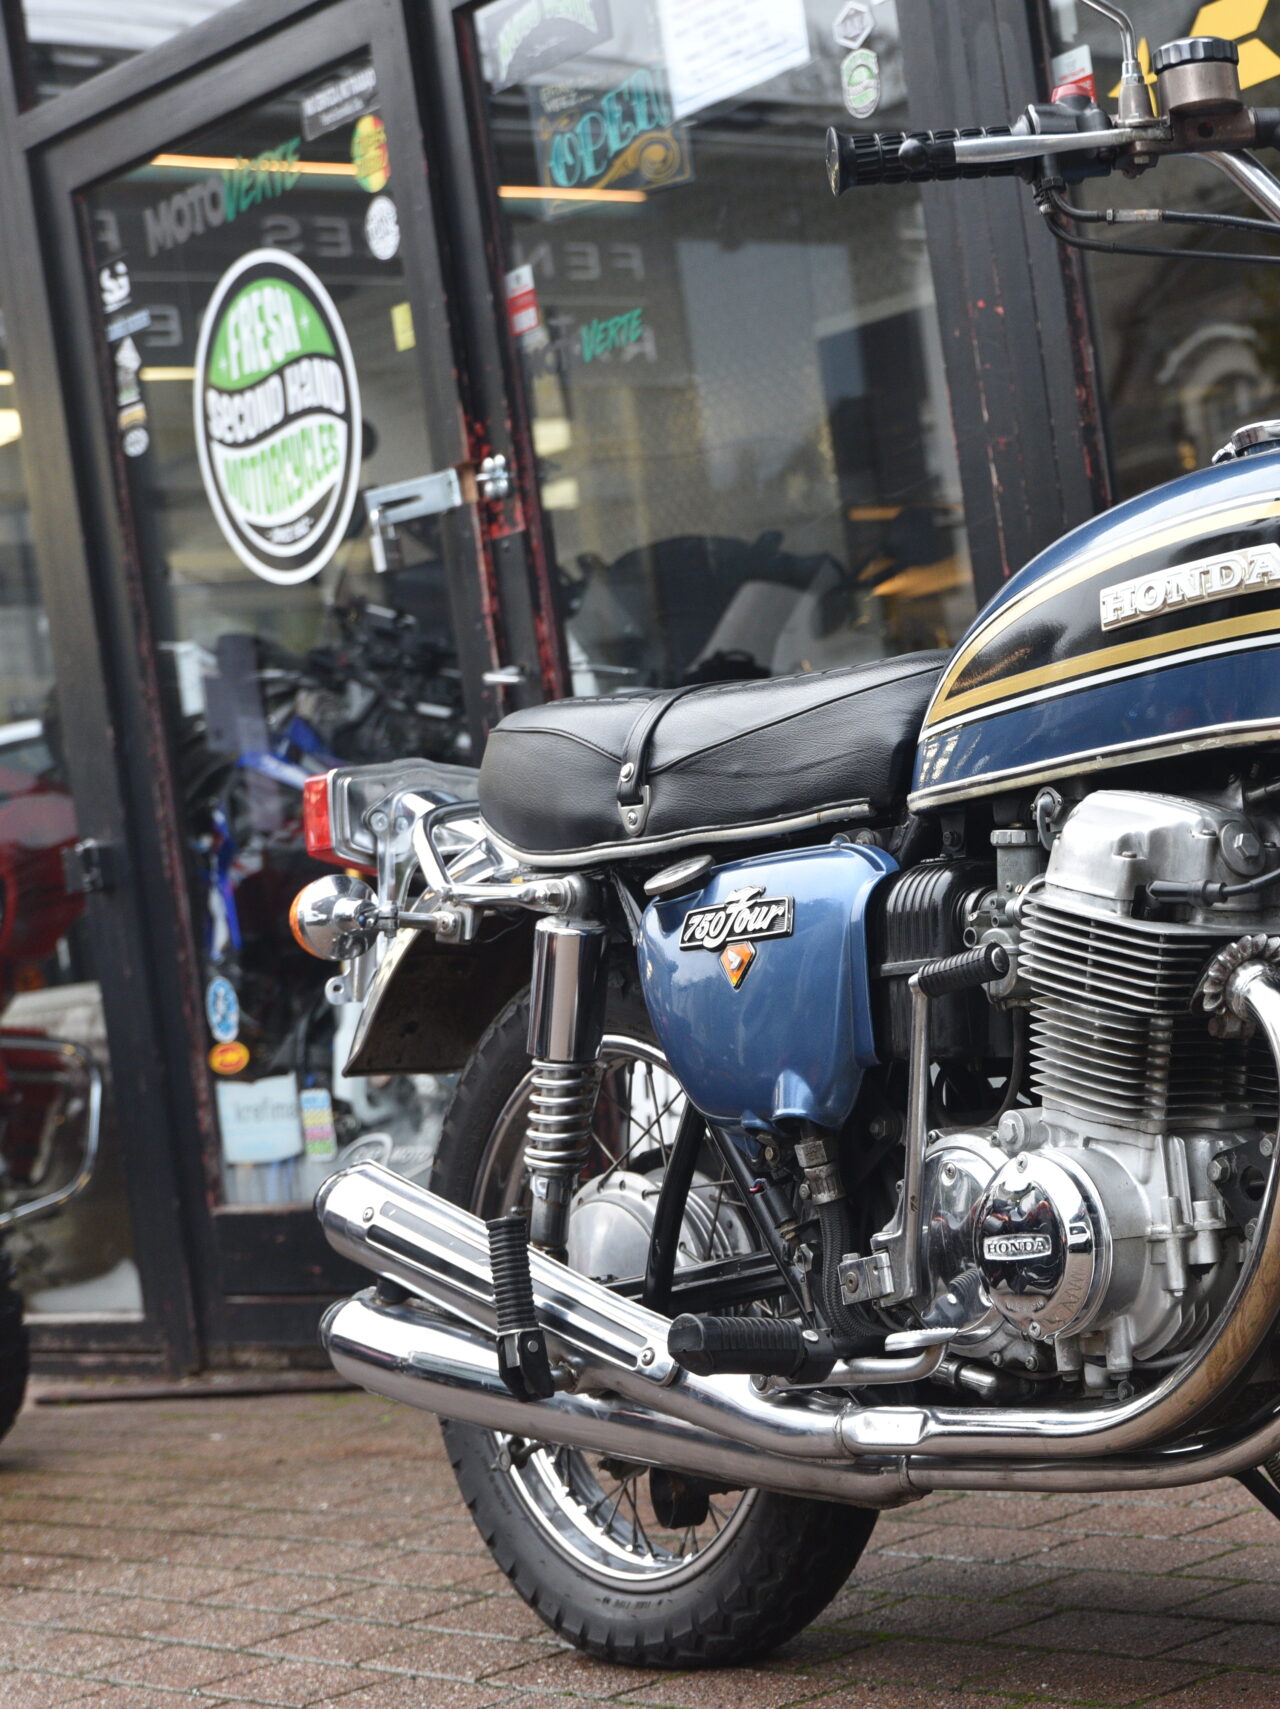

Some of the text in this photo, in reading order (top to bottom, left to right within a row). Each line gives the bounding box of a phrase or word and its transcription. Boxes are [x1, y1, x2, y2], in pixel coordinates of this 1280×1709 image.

[549, 66, 677, 188] OPEN
[143, 174, 227, 258] MOTO
[226, 285, 303, 381] FRESH
[581, 307, 643, 363] VERTE
[223, 423, 341, 516] MOTORCYCLES
[683, 886, 785, 949] 750 Four
[986, 1238, 1048, 1255] HONDA
